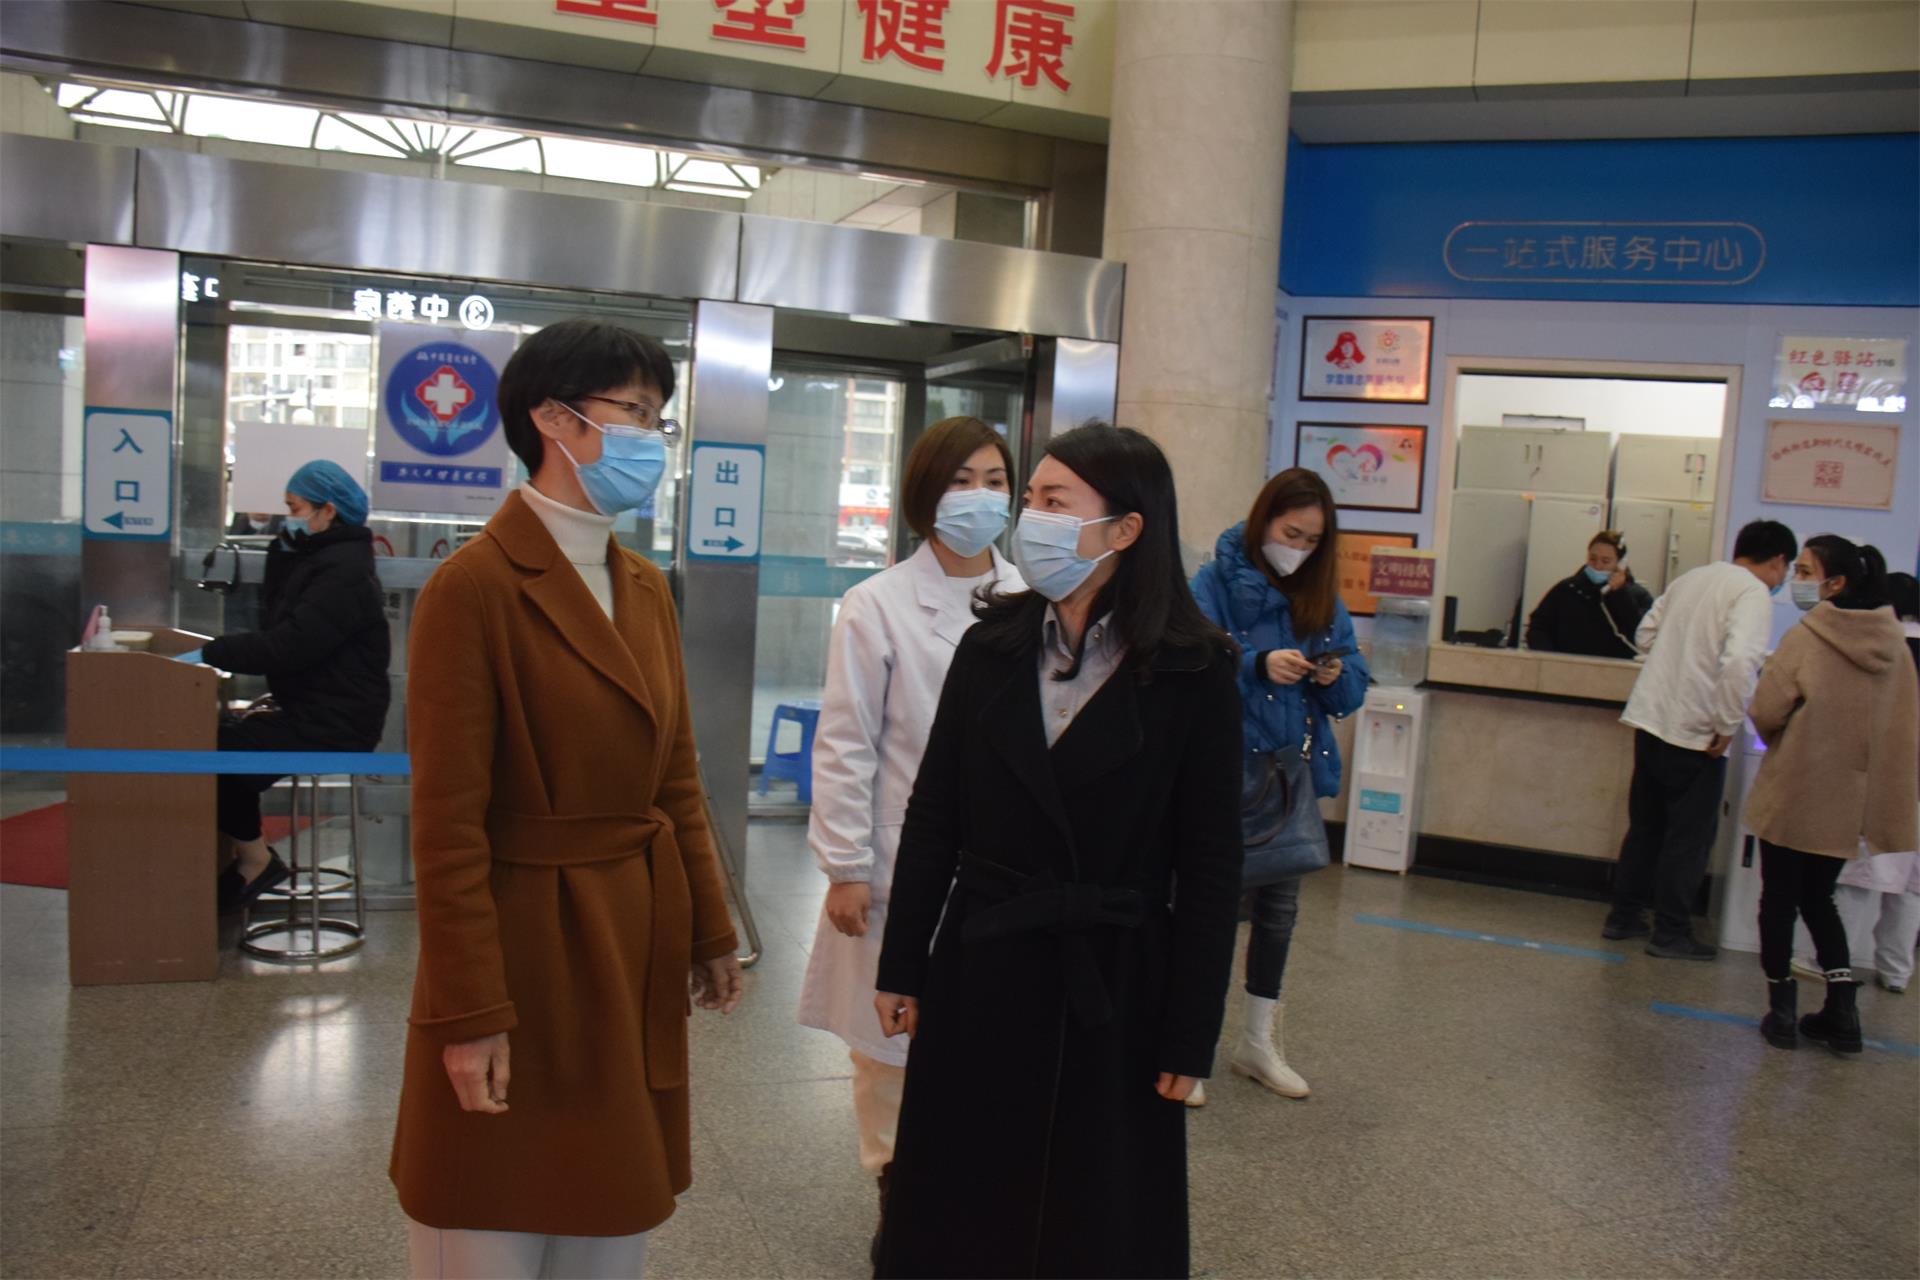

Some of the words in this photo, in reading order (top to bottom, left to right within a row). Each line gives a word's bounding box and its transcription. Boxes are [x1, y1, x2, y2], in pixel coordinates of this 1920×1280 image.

[1465, 235, 1744, 272] 一站式服务中心
[112, 427, 144, 502] 入口
[715, 459, 739, 528] 出口
